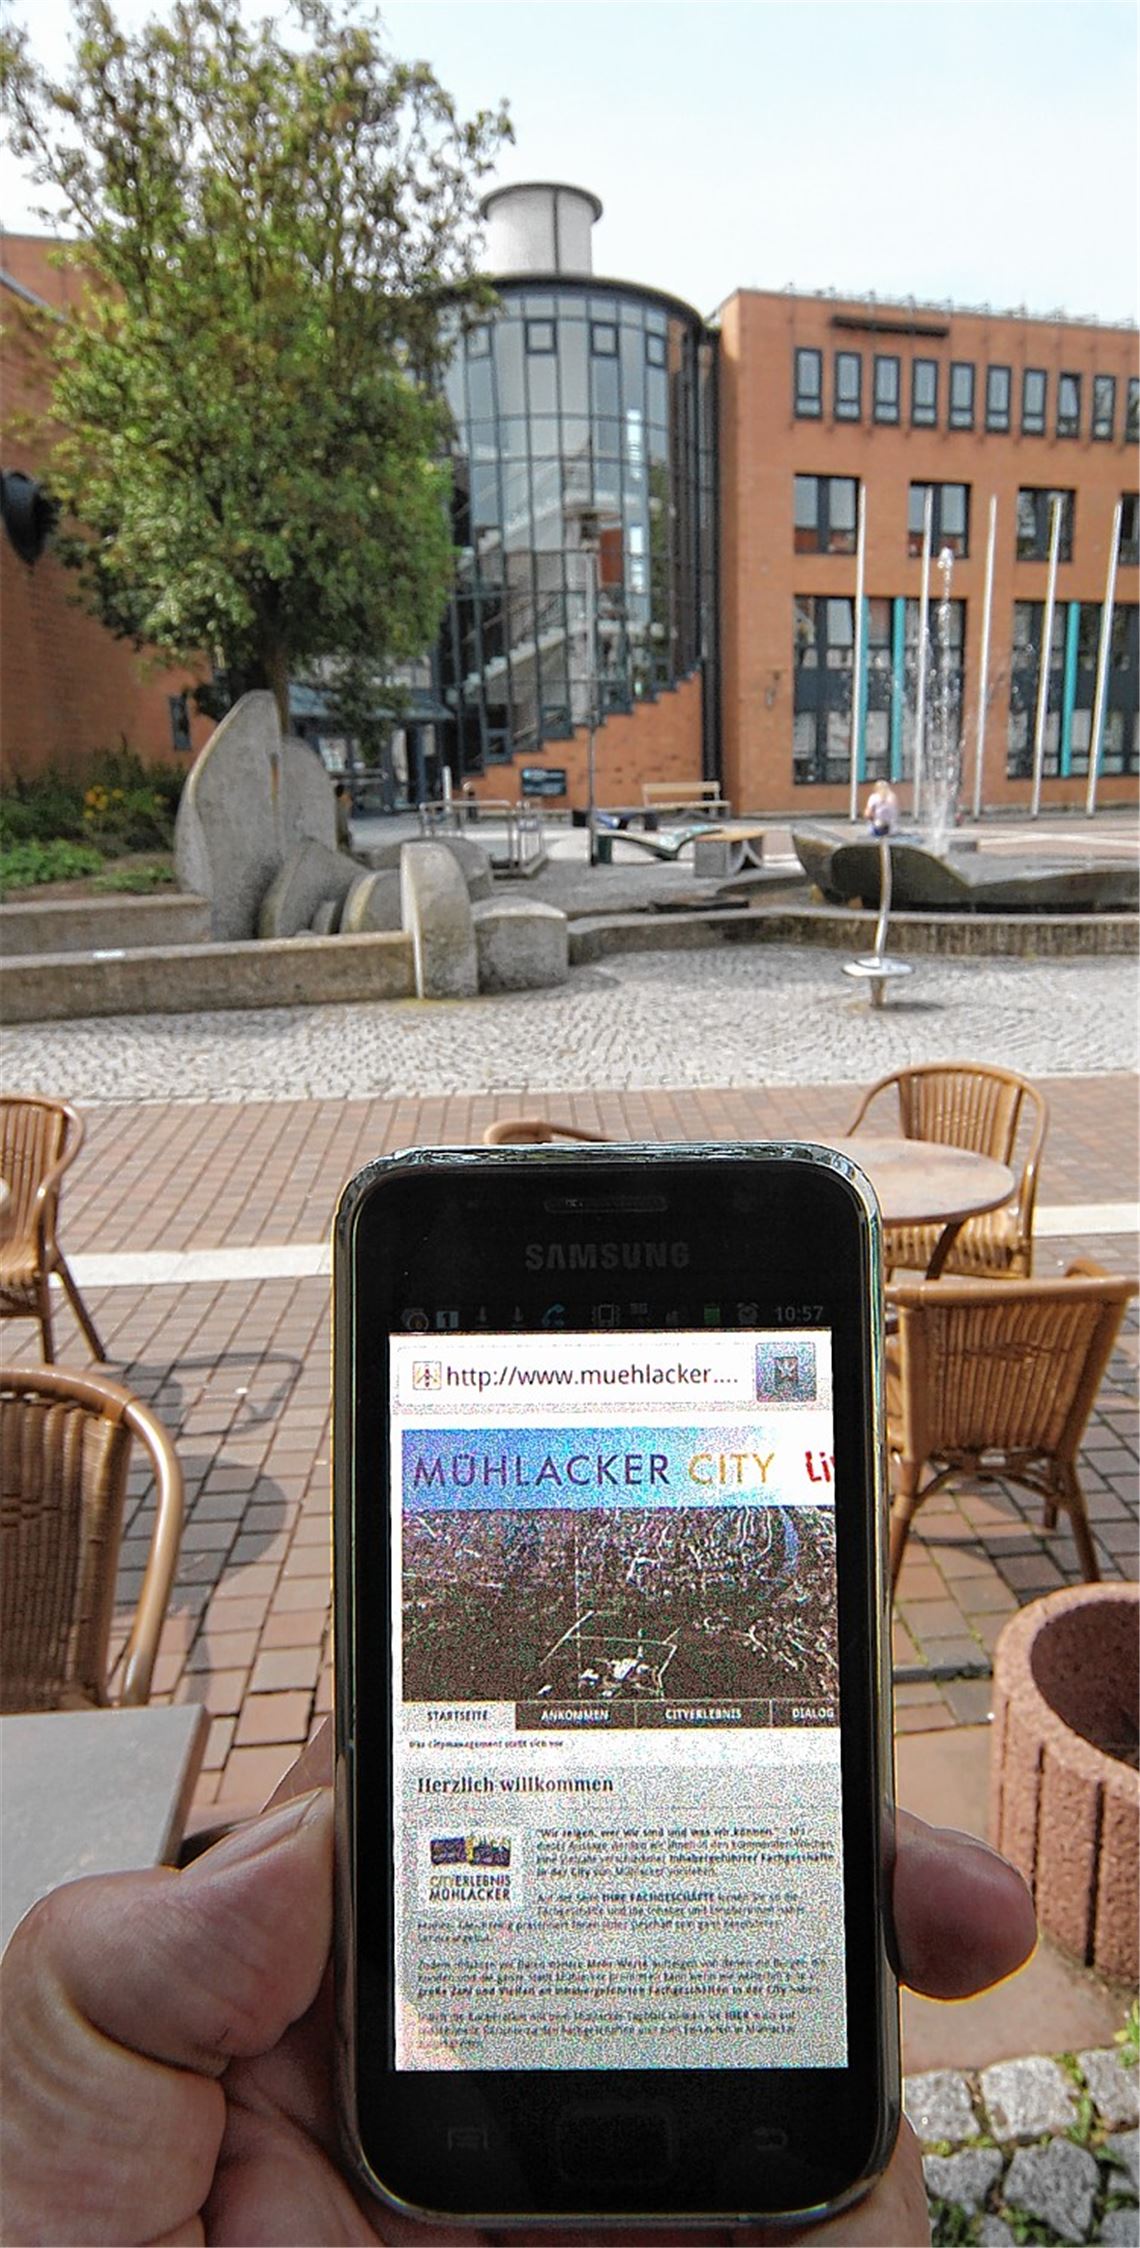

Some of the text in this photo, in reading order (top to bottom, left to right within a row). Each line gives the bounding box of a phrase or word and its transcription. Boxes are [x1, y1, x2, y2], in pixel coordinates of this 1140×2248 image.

[525, 1242, 690, 1270] SAMSUNG
[775, 1305, 824, 1323] 10:57
[447, 1363, 739, 1392] http://www.muehlacker....
[413, 1452, 776, 1488] MÜHLACKER CITY
[427, 1710, 488, 1722] STARTSEITE
[541, 1709, 610, 1721] ANKOMMEN
[665, 1708, 742, 1720] CITYERLEBNIS
[792, 1707, 835, 1719] DIALOG
[418, 1776, 614, 1793] Herzlich willkommen
